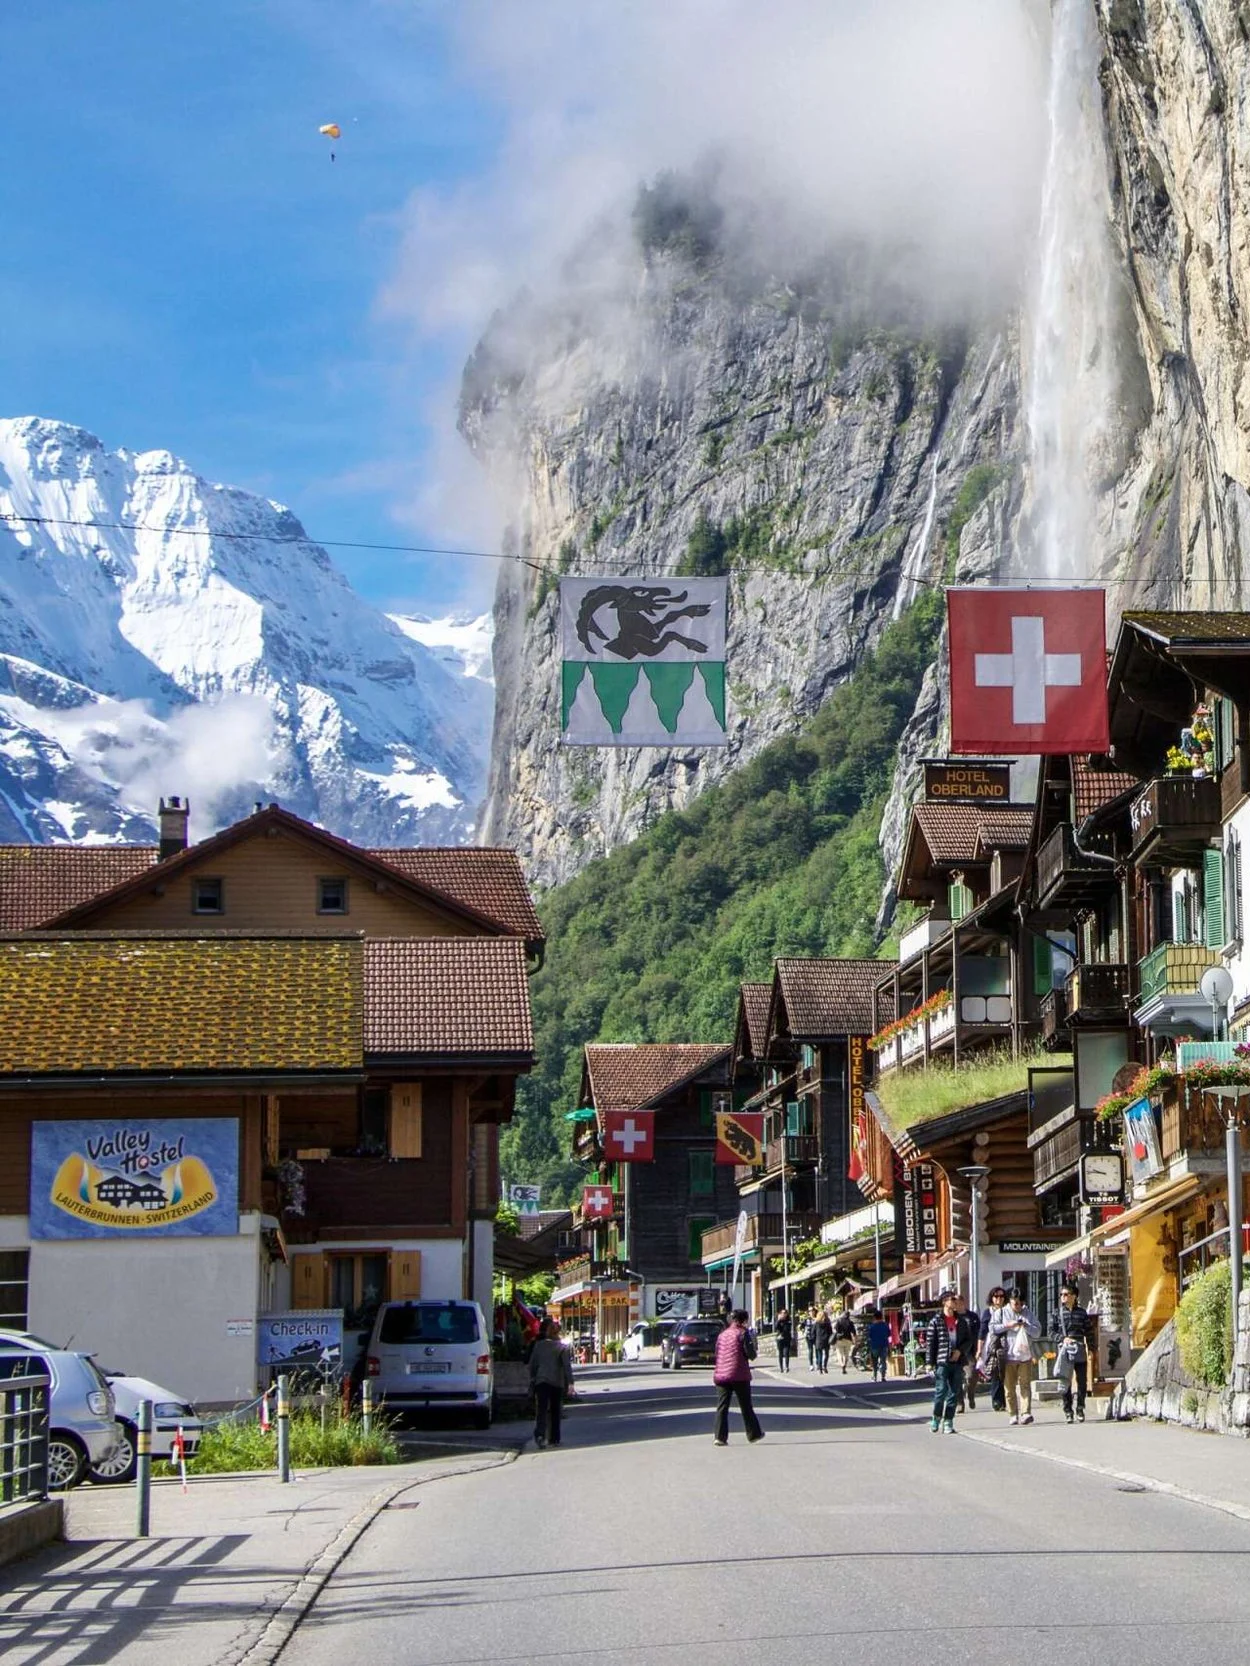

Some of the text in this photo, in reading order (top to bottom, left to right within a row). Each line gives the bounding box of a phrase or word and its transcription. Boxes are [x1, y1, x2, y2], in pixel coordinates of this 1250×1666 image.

[931, 783, 1004, 796] OBERLAND
[946, 770, 990, 782] HOTEL
[852, 1037, 862, 1084] HOTEL
[87, 1130, 150, 1160] Valley
[120, 1136, 185, 1174] Hostel
[56, 1191, 214, 1225] LAUTERBRUNNEN SWITZERLAND
[903, 1190, 915, 1252] IMBODEN
[270, 1321, 329, 1336] Check-in
